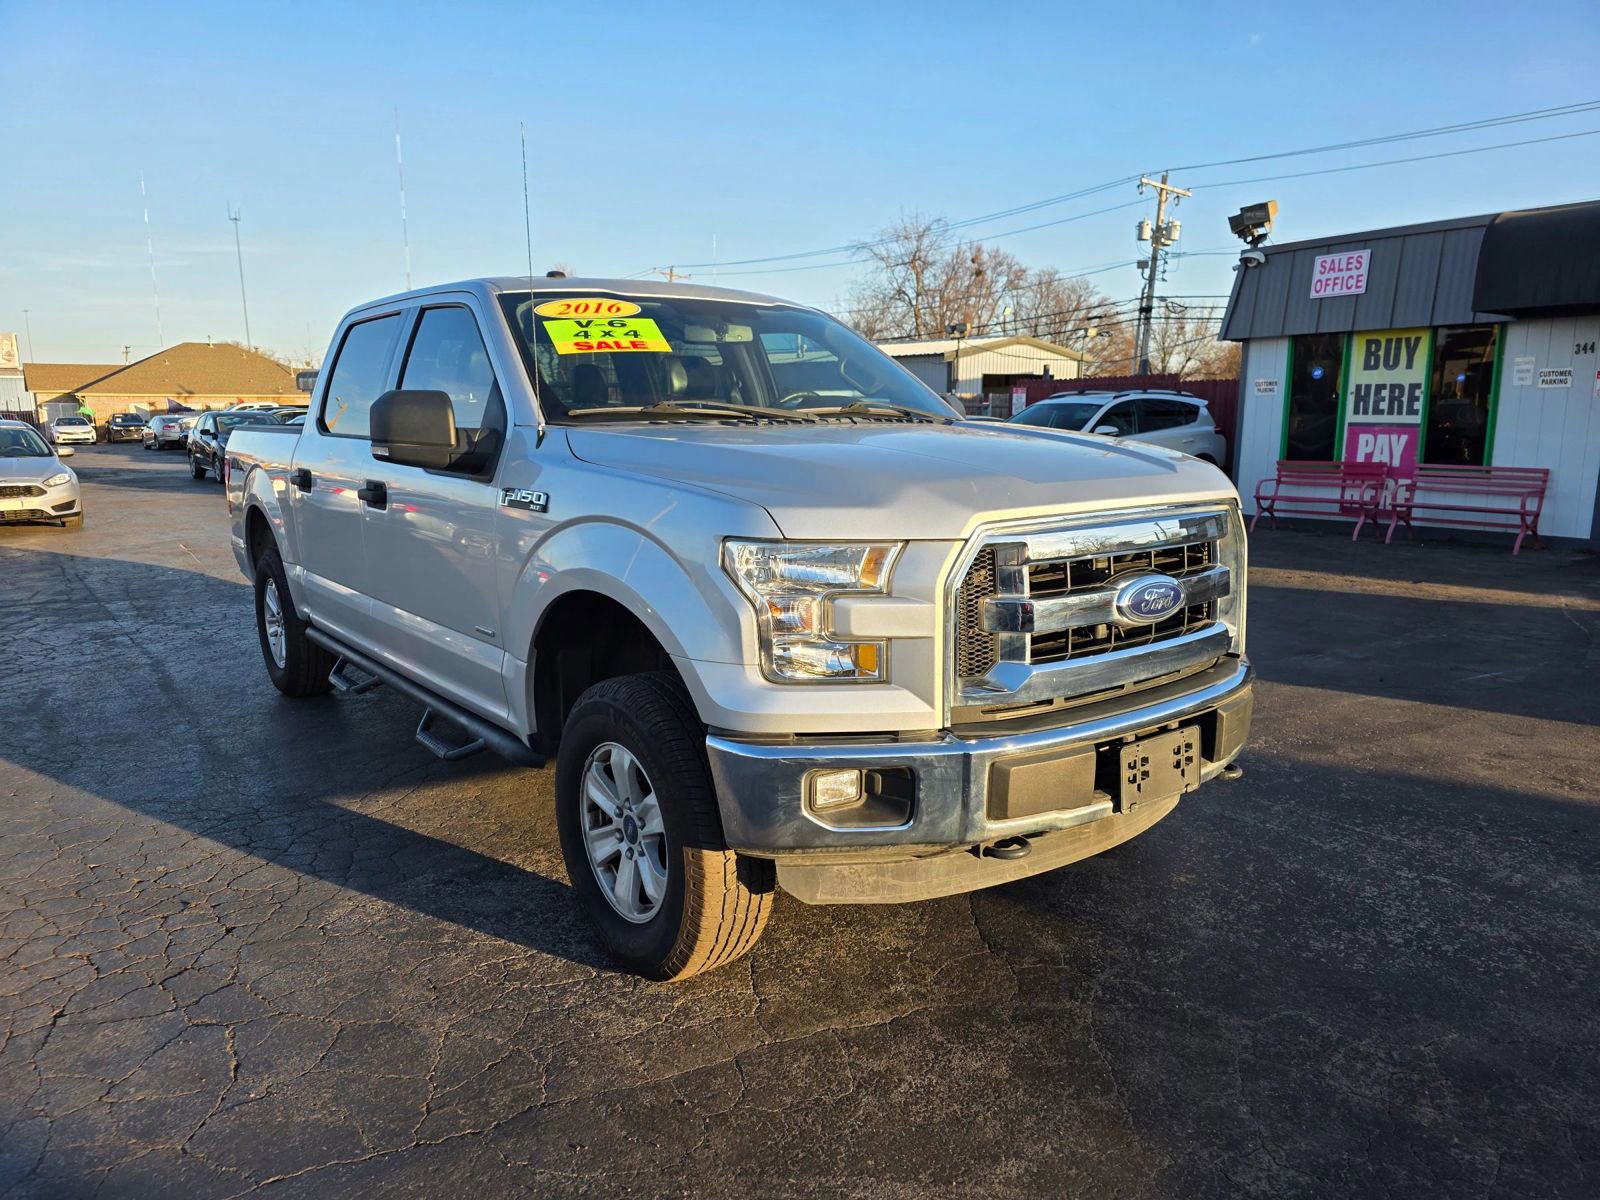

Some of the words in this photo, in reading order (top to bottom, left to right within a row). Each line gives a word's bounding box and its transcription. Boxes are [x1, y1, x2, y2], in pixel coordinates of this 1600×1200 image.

[1319, 255, 1363, 275] SALES
[1314, 273, 1364, 294] OFFICE
[557, 302, 621, 315] 2016
[574, 319, 628, 329] V-6
[572, 340, 649, 351] SALE
[1363, 336, 1422, 371] BUY
[1574, 341, 1596, 355] 344
[1539, 370, 1573, 378] CUSTOMER
[1353, 383, 1422, 416] HERE
[1356, 433, 1409, 468] PAY
[1141, 587, 1175, 613] Ford
